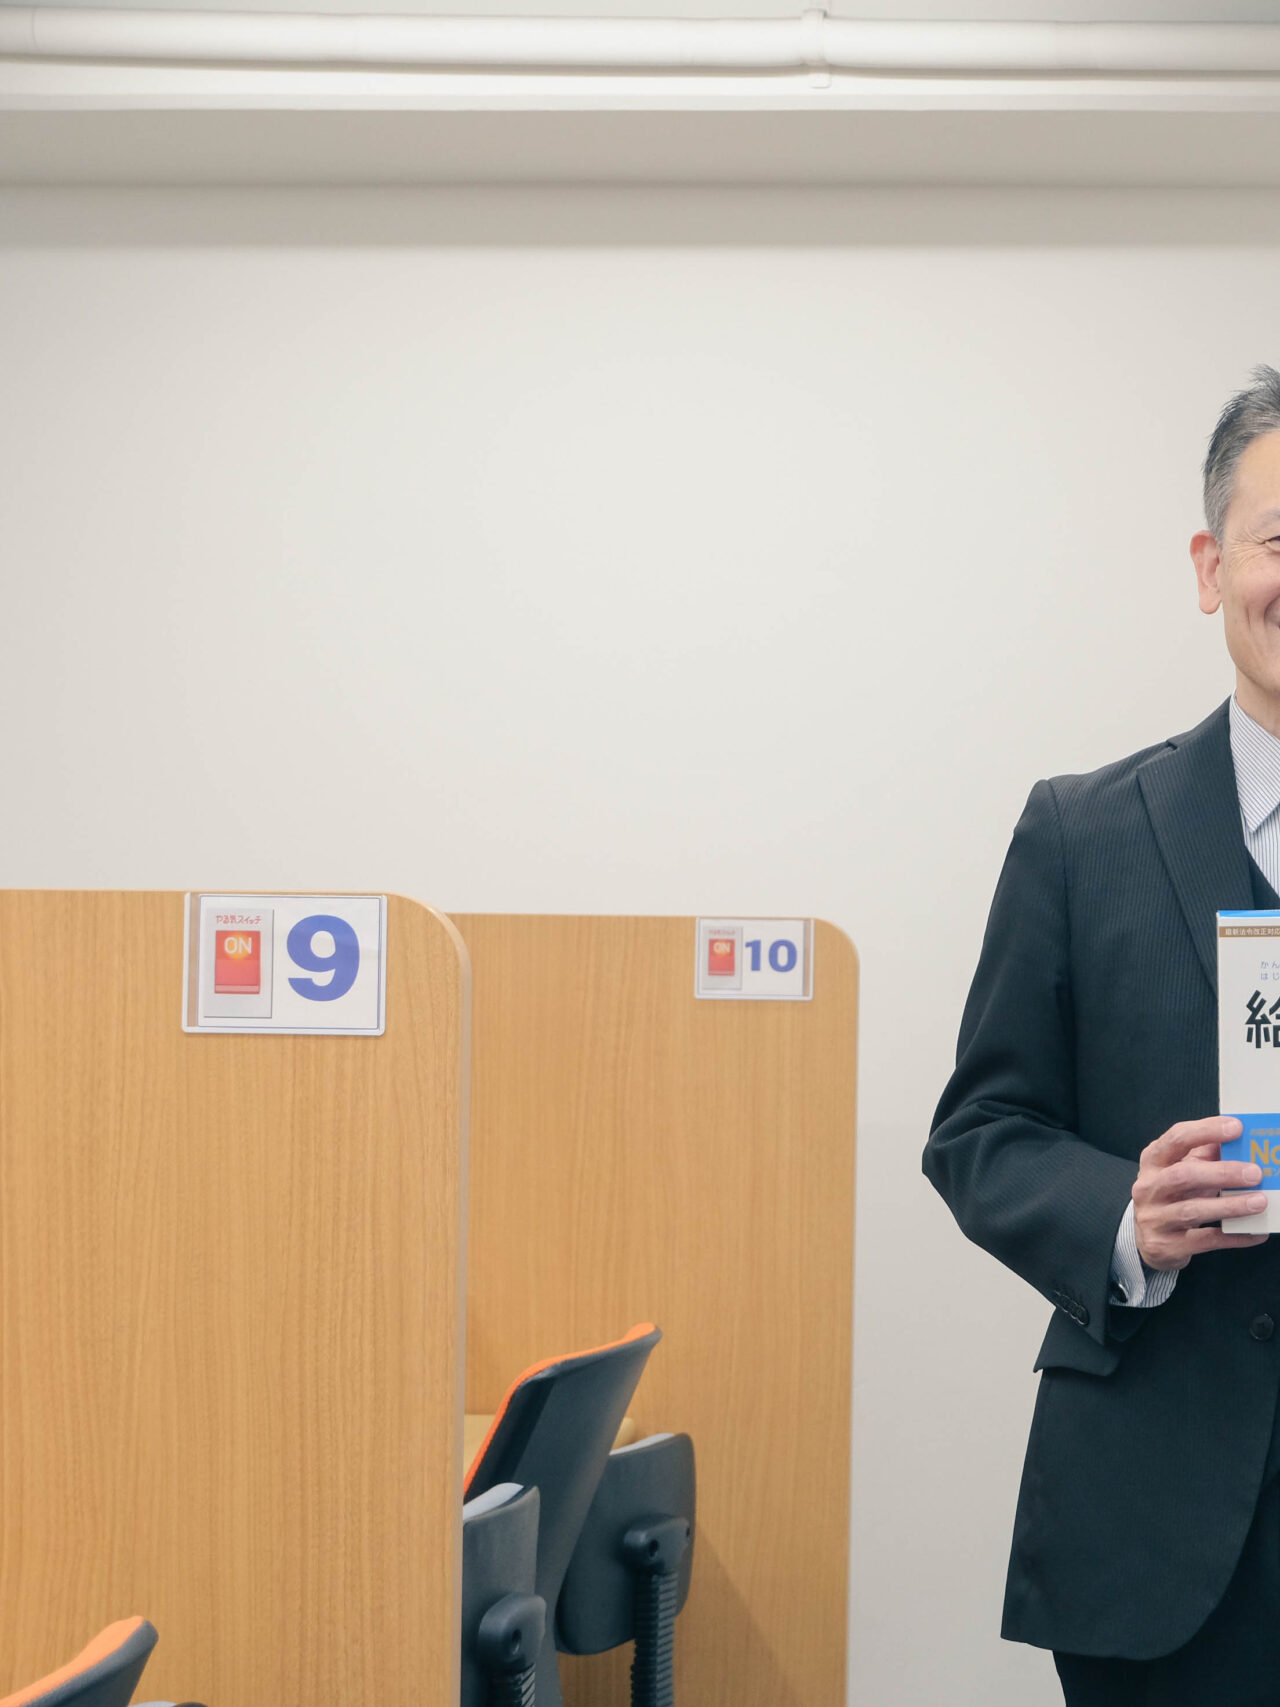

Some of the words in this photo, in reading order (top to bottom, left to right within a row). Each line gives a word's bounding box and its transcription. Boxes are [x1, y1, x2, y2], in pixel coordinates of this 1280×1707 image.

[215, 914, 263, 925] やる気スイッチ
[224, 936, 252, 955] ON
[713, 941, 731, 954] ON
[286, 914, 360, 1002] 9
[745, 938, 798, 973] 10
